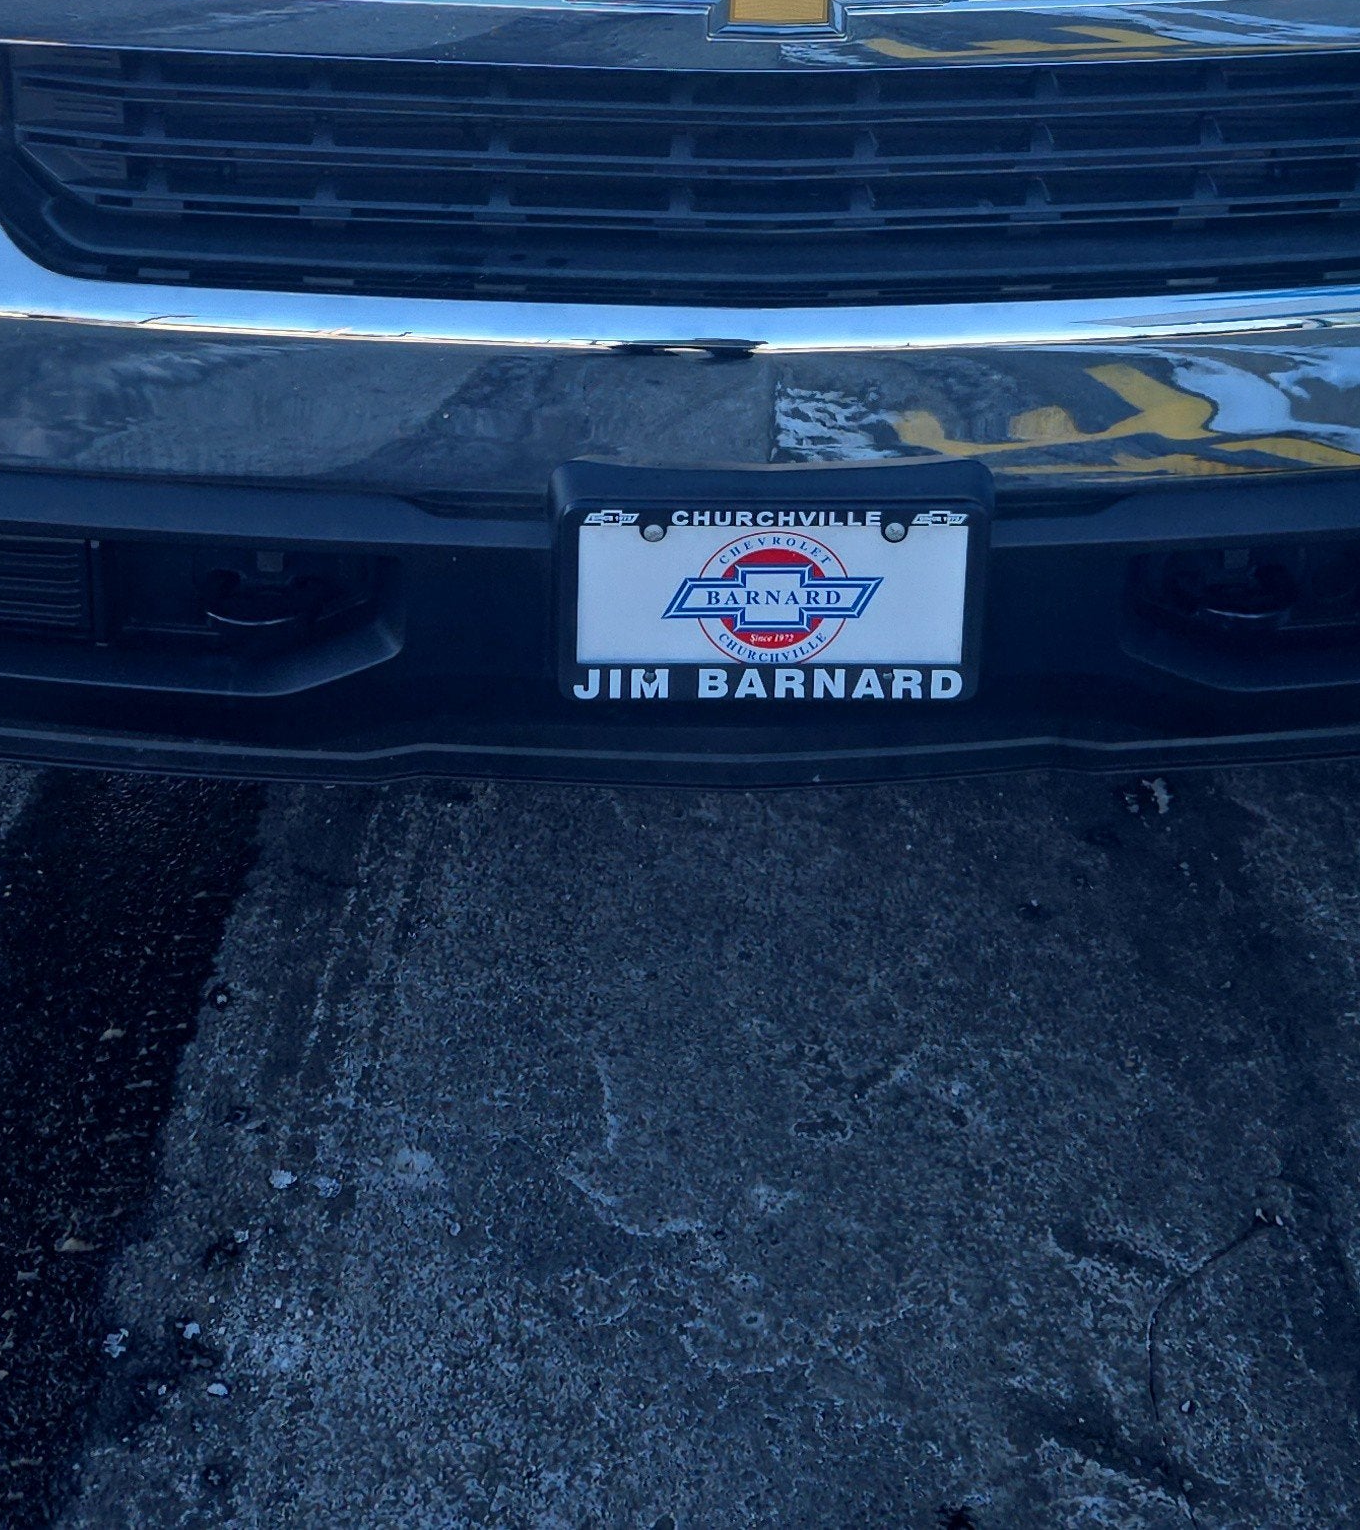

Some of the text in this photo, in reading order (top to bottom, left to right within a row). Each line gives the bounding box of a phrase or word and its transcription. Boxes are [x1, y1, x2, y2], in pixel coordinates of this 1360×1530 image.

[671, 511, 882, 527] CHURCHVILLE
[719, 537, 831, 565] CHEVROLET
[706, 590, 841, 605] BARNARD
[718, 633, 827, 663] CHURCHVILLE
[749, 634, 773, 645] Since
[574, 669, 963, 700] JIM BARNARD
